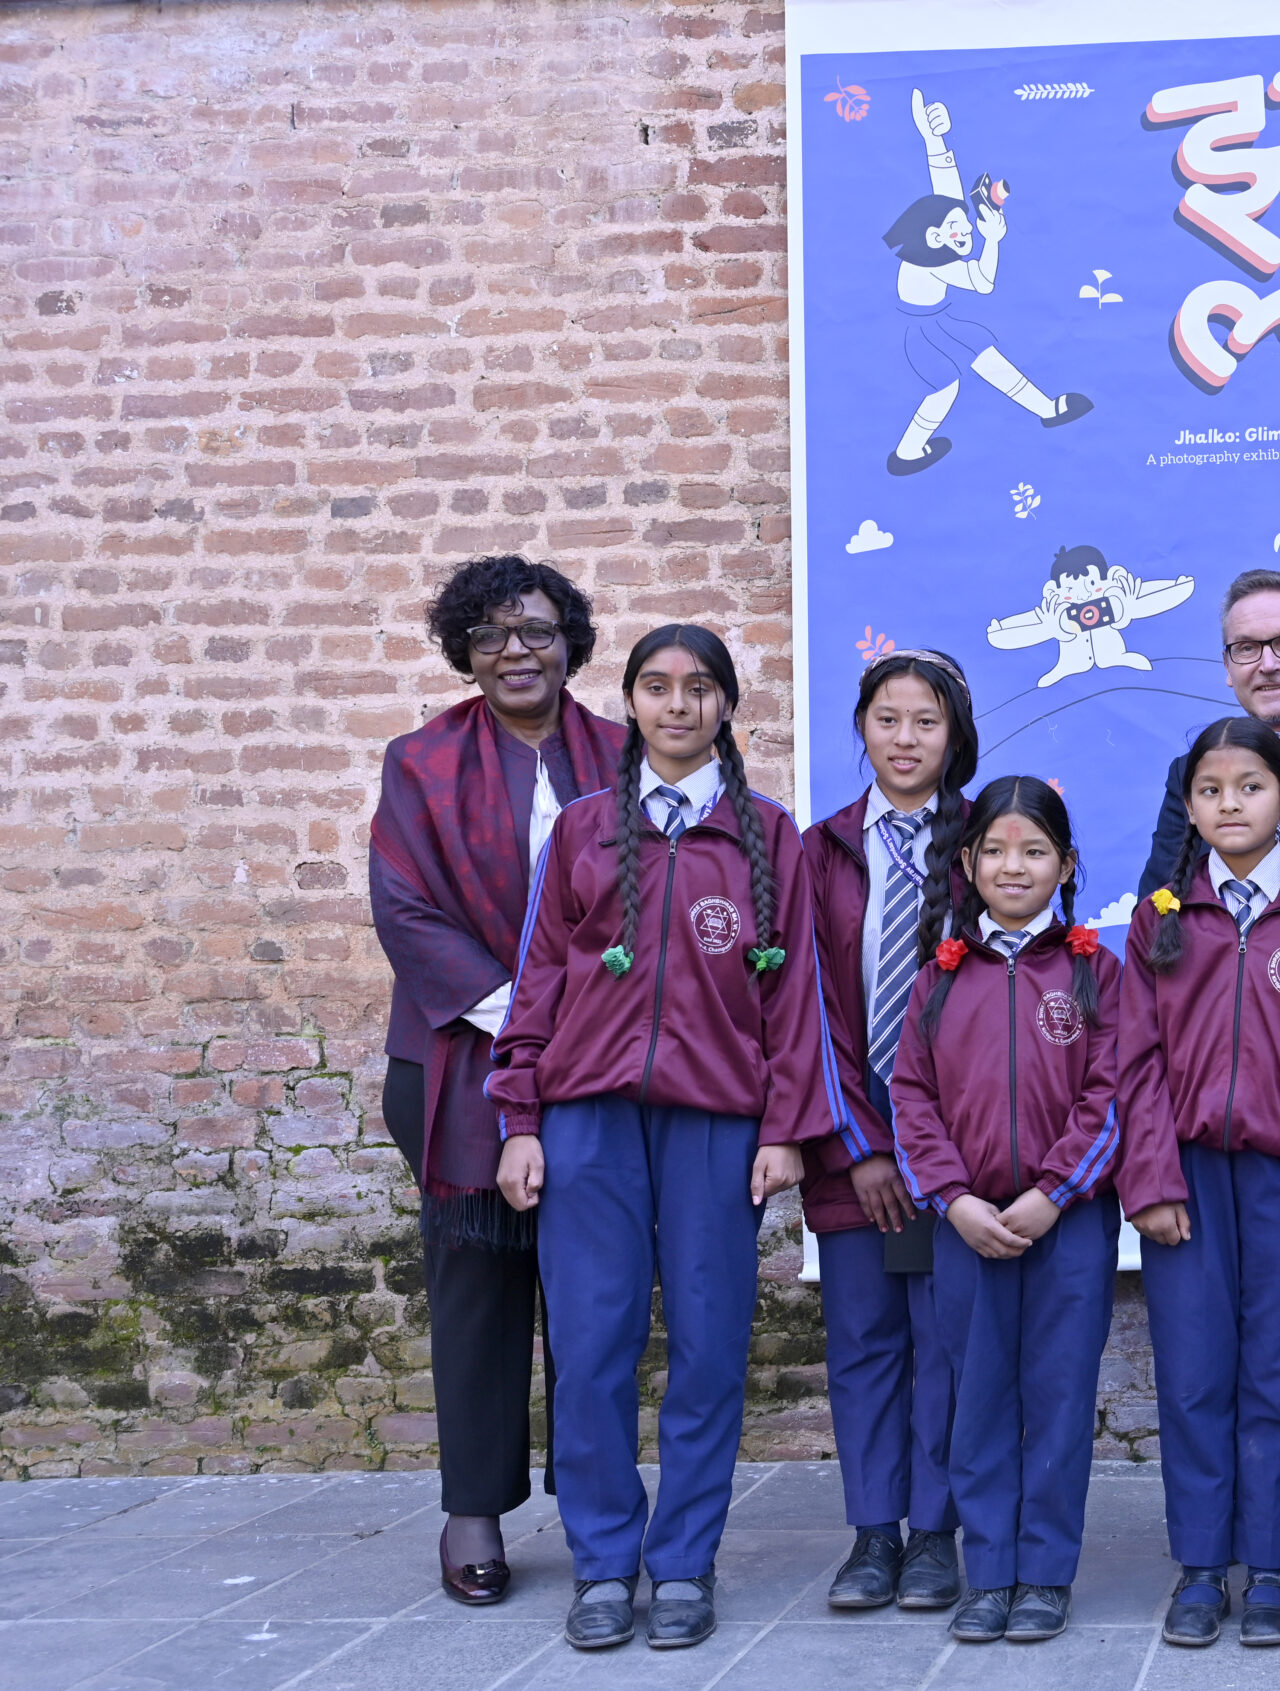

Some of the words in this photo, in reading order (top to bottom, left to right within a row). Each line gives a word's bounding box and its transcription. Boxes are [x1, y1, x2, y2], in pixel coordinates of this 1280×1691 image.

[1175, 428, 1240, 445] Jhalko:
[1146, 454, 1157, 465] A
[1160, 451, 1240, 467] photography
[887, 838, 907, 869] Secondary
[906, 867, 924, 887] hairav
